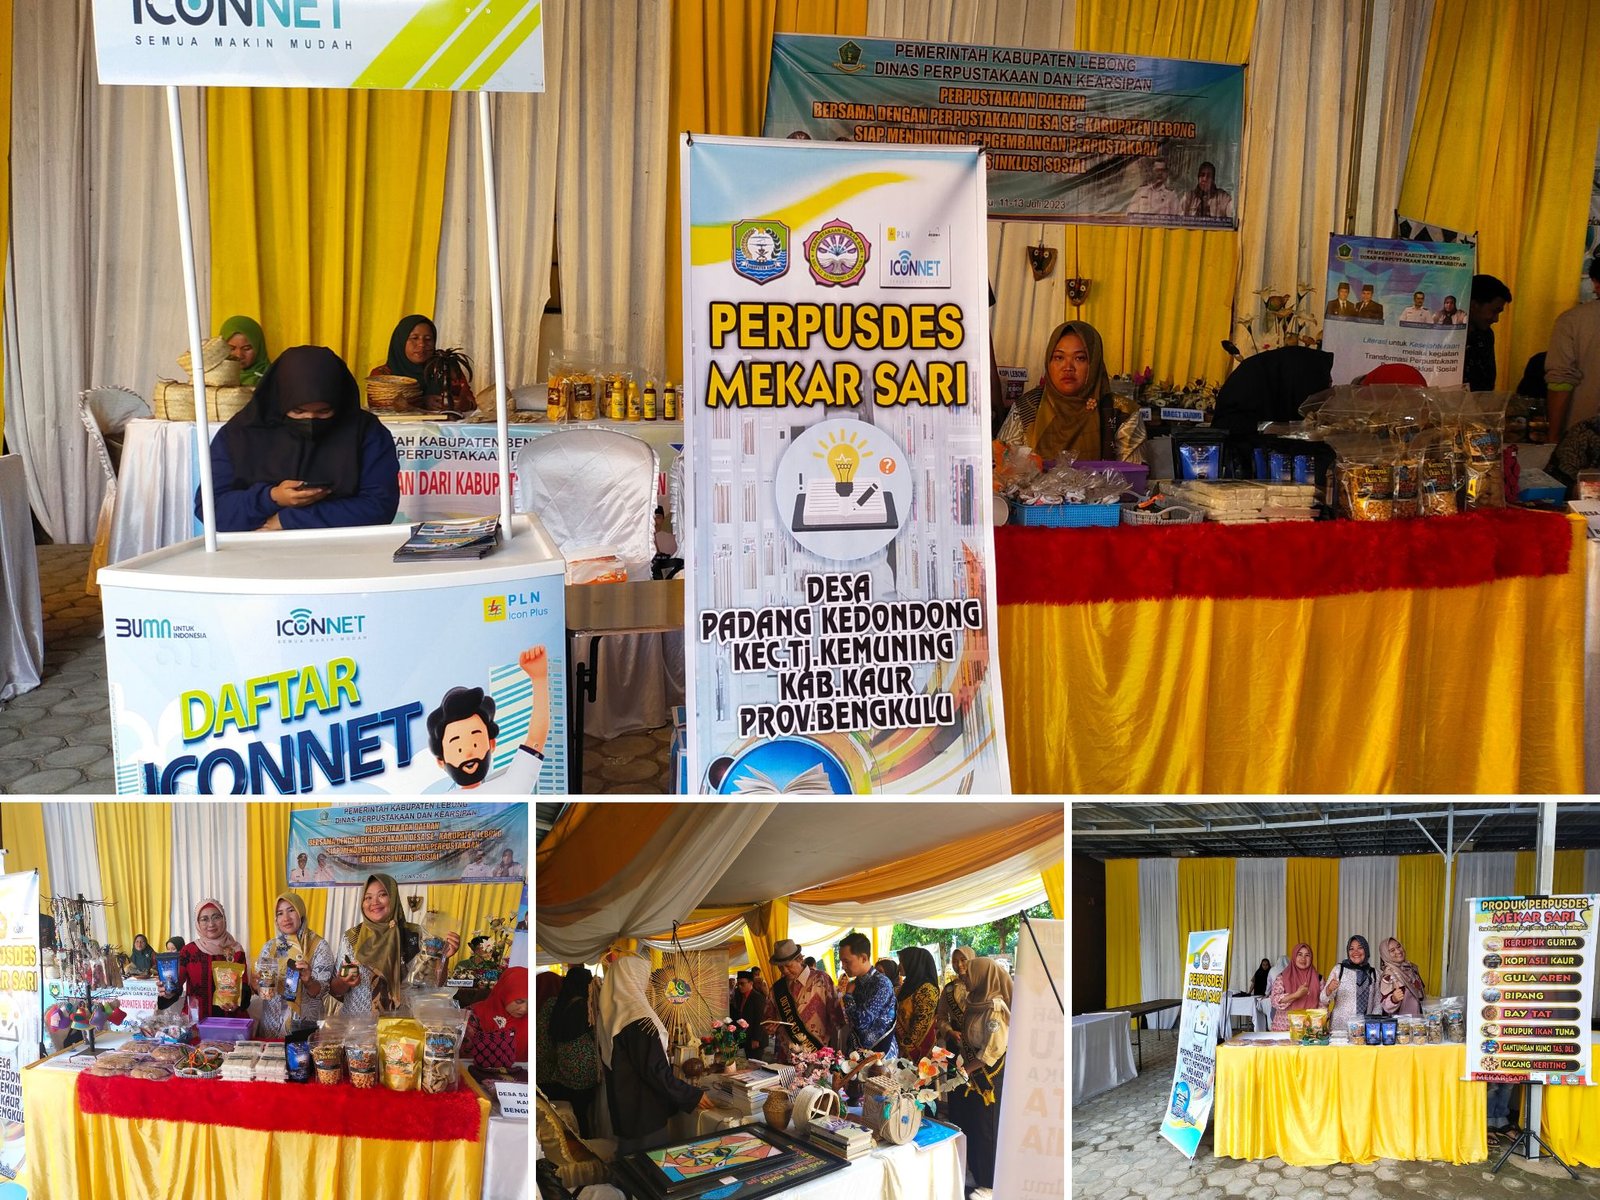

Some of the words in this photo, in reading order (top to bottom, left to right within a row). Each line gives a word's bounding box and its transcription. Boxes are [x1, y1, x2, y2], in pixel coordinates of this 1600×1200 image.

[135, 35, 198, 47] SEMUA
[214, 37, 273, 48] MAKIN
[290, 39, 353, 50] MUDAH
[895, 43, 988, 62] PEMERINTAH
[992, 49, 1076, 68] KABUPATEN
[1080, 55, 1137, 72] LEBONG
[874, 61, 919, 77] DINAS
[923, 63, 1039, 85] PERPUSTAKAAN
[1043, 72, 1072, 86] DAN
[1076, 74, 1153, 92] KEARSIPAN
[939, 86, 1037, 109] PERPUSTAKAAN
[1038, 92, 1087, 111] DAERAH
[813, 101, 876, 121] BERSAMA
[877, 105, 927, 124] DENGAN
[929, 108, 1026, 130] PERPUSTAKAAN
[1028, 114, 1060, 131] DESA
[1084, 117, 1150, 137] KABUPATEN
[1152, 120, 1196, 139] LEBONG
[854, 125, 885, 143] SIAP
[886, 126, 967, 144] MENDUKUNG
[968, 132, 1068, 154] PENGEMBANGAN
[1069, 138, 1160, 158] PERPUSTAKAAN
[994, 154, 1043, 172] INKLUSI
[1044, 157, 1088, 174] SOSIAL
[1000, 199, 1024, 208] 11-13
[1044, 200, 1066, 209] 2023
[890, 258, 941, 277] ICONNET
[709, 301, 965, 350] PERPUSDES
[1388, 339, 1407, 347] untuk
[705, 360, 863, 408] MEKAR
[872, 361, 970, 408] SARI
[419, 435, 499, 448] KABUPATEN
[397, 449, 502, 462] PERPUSTAKAA
[419, 470, 451, 496] DARI
[806, 573, 871, 604] DESA
[508, 591, 540, 606] PLN
[508, 611, 528, 620] Icon
[530, 608, 549, 617] Plus
[701, 608, 812, 642] PADANG
[821, 600, 981, 636] KEDONDONG
[276, 614, 366, 637] ICONNET
[180, 657, 362, 743] DAFTAR
[344, 805, 388, 814] PEMERINTAH
[391, 802, 436, 812] KABUPATEN
[357, 812, 415, 823] PERPUSTAKAAN
[1481, 899, 1526, 911] PRODUK
[1528, 897, 1589, 910] PERPUSDES
[1491, 912, 1541, 924] MEKAR
[1545, 911, 1575, 923] SARI
[1505, 938, 1545, 947] KERUPUK
[1547, 938, 1577, 947] GURITA
[1504, 956, 1527, 965] KOPI
[1528, 956, 1549, 965] ASLI
[1550, 957, 1575, 965] KAUR
[12, 969, 39, 992] SARI
[1189, 972, 1223, 988] PERPUSDES
[1503, 974, 1537, 982] GULA
[1539, 974, 1572, 982] AREN
[1504, 992, 1544, 1000] BIPANG
[1504, 1009, 1528, 1018] BAY
[1531, 1010, 1552, 1018] TAT
[1503, 1027, 1533, 1035] KRUPUK
[1535, 1027, 1553, 1036] IKAN
[1555, 1028, 1575, 1036] TUNA
[1502, 1044, 1534, 1052] GANTUNGAN
[1502, 1060, 1531, 1069] KACANG
[1533, 1061, 1567, 1070] KERITING
